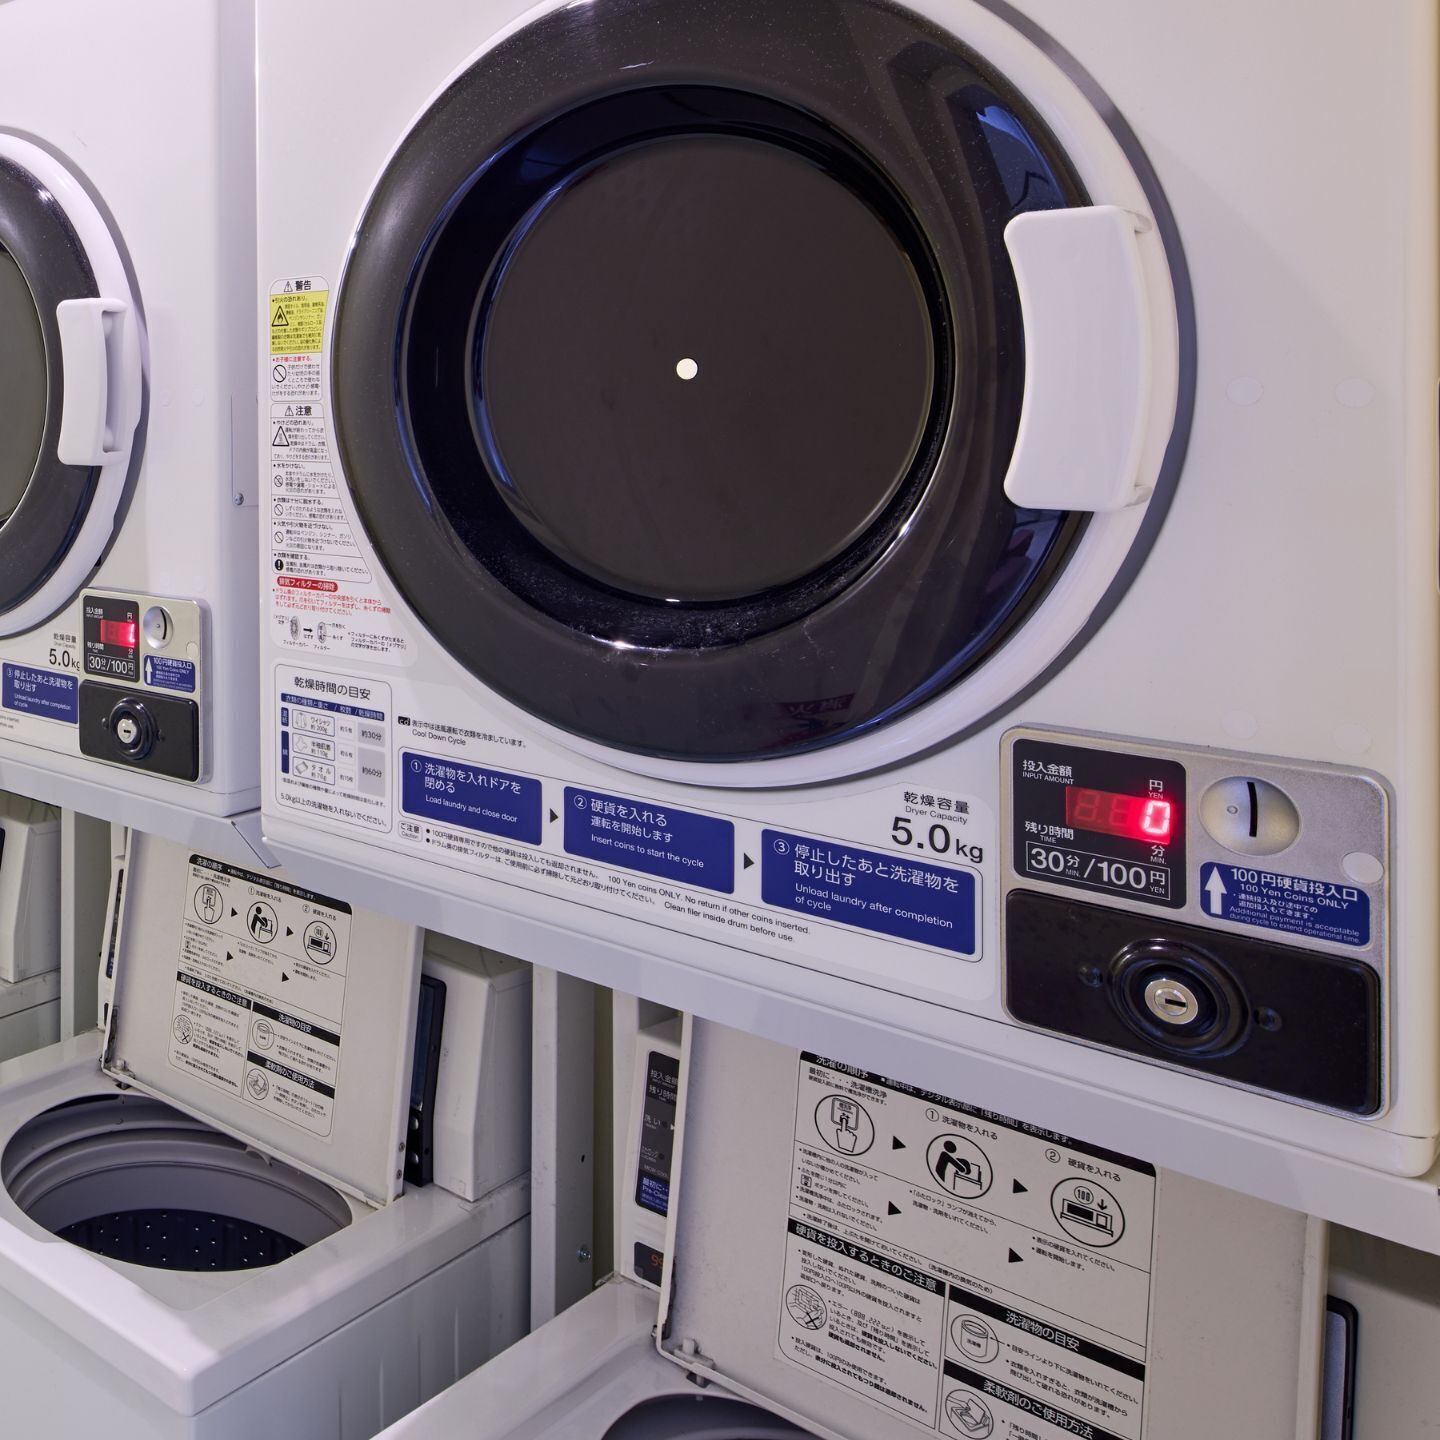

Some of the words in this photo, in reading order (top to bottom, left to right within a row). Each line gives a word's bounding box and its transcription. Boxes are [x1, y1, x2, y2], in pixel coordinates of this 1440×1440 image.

[296, 280, 311, 291] 警告
[296, 406, 312, 416] 注意
[13, 669, 73, 690] 停止したあと洗濯物を
[13, 682, 38, 693] 取り出す
[294, 677, 371, 700] 乾燥時間の目安
[361, 730, 382, 741] 約30分
[412, 729, 426, 738] Cool
[428, 732, 447, 742] Down
[448, 736, 466, 746] Cycle
[362, 766, 382, 778] 約60分
[425, 762, 521, 795] 洗濯物を入れドアを
[1022, 760, 1072, 778] 投入金額
[1022, 771, 1042, 780] INPUT
[1044, 775, 1074, 785] AMOUNT
[425, 777, 455, 793] 閉める
[1149, 779, 1163, 792] 円
[426, 795, 442, 805] Load
[443, 797, 467, 812] laundry
[468, 805, 481, 814] and
[482, 808, 500, 819] close
[502, 812, 518, 823] door
[590, 798, 667, 827] 硬貨を入れる
[903, 791, 969, 815] 乾燥容量
[905, 805, 927, 816] Dryer
[929, 810, 968, 825] Capacity
[400, 822, 420, 834] ご注意
[590, 815, 673, 843] 運転を開始します
[1024, 821, 1074, 840] 残り時間
[1040, 835, 1057, 844] TIME
[1151, 844, 1166, 857] 分
[591, 834, 612, 846] Insert
[614, 839, 635, 851] coins
[637, 844, 645, 853] to
[647, 847, 665, 859] start
[667, 852, 680, 862] the
[682, 856, 704, 868] cycle
[1150, 856, 1167, 864] MIN.
[794, 843, 959, 894] 停止したあと洗濯物を
[794, 859, 856, 887] 取り出す
[1065, 868, 1081, 877] MIN.
[607, 875, 621, 886] 100
[622, 877, 637, 889] Yen
[637, 882, 657, 895] coins
[658, 887, 684, 901] ONLY.
[685, 894, 696, 904] No
[697, 898, 720, 911] return
[729, 906, 749, 918] other
[750, 911, 774, 925] coins
[1149, 886, 1165, 894] YEN
[1240, 883, 1258, 892] 100
[1261, 887, 1281, 897] Yen
[1284, 891, 1314, 904] Coins
[1317, 898, 1349, 910] ONLY
[795, 895, 804, 904] of
[807, 898, 832, 912] cycle
[795, 882, 828, 899] Unload
[831, 891, 867, 910] laundry
[869, 902, 893, 914] after
[895, 908, 954, 929] completion
[664, 901, 686, 913] Clean
[702, 910, 726, 924] inside
[727, 916, 748, 930] drum
[749, 922, 776, 938] before
[1229, 906, 1268, 919] Additional
[1270, 914, 1304, 926] payment
[1314, 923, 1360, 937] acceptable
[1229, 913, 1251, 923] during
[1252, 917, 1270, 926] cycle
[1279, 922, 1303, 932] extend
[1304, 927, 1343, 940] operational
[1343, 934, 1361, 944] time.
[941, 1115, 998, 1140] 洗濯物を入れる
[1067, 1157, 1122, 1182] 硬貨を入れる
[795, 1223, 937, 1293] 硬貨を投入するときのご注意
[1006, 1310, 1080, 1352] 洗濯物の目安
[983, 1380, 1093, 1440] 柔軟剤のご使用方法
